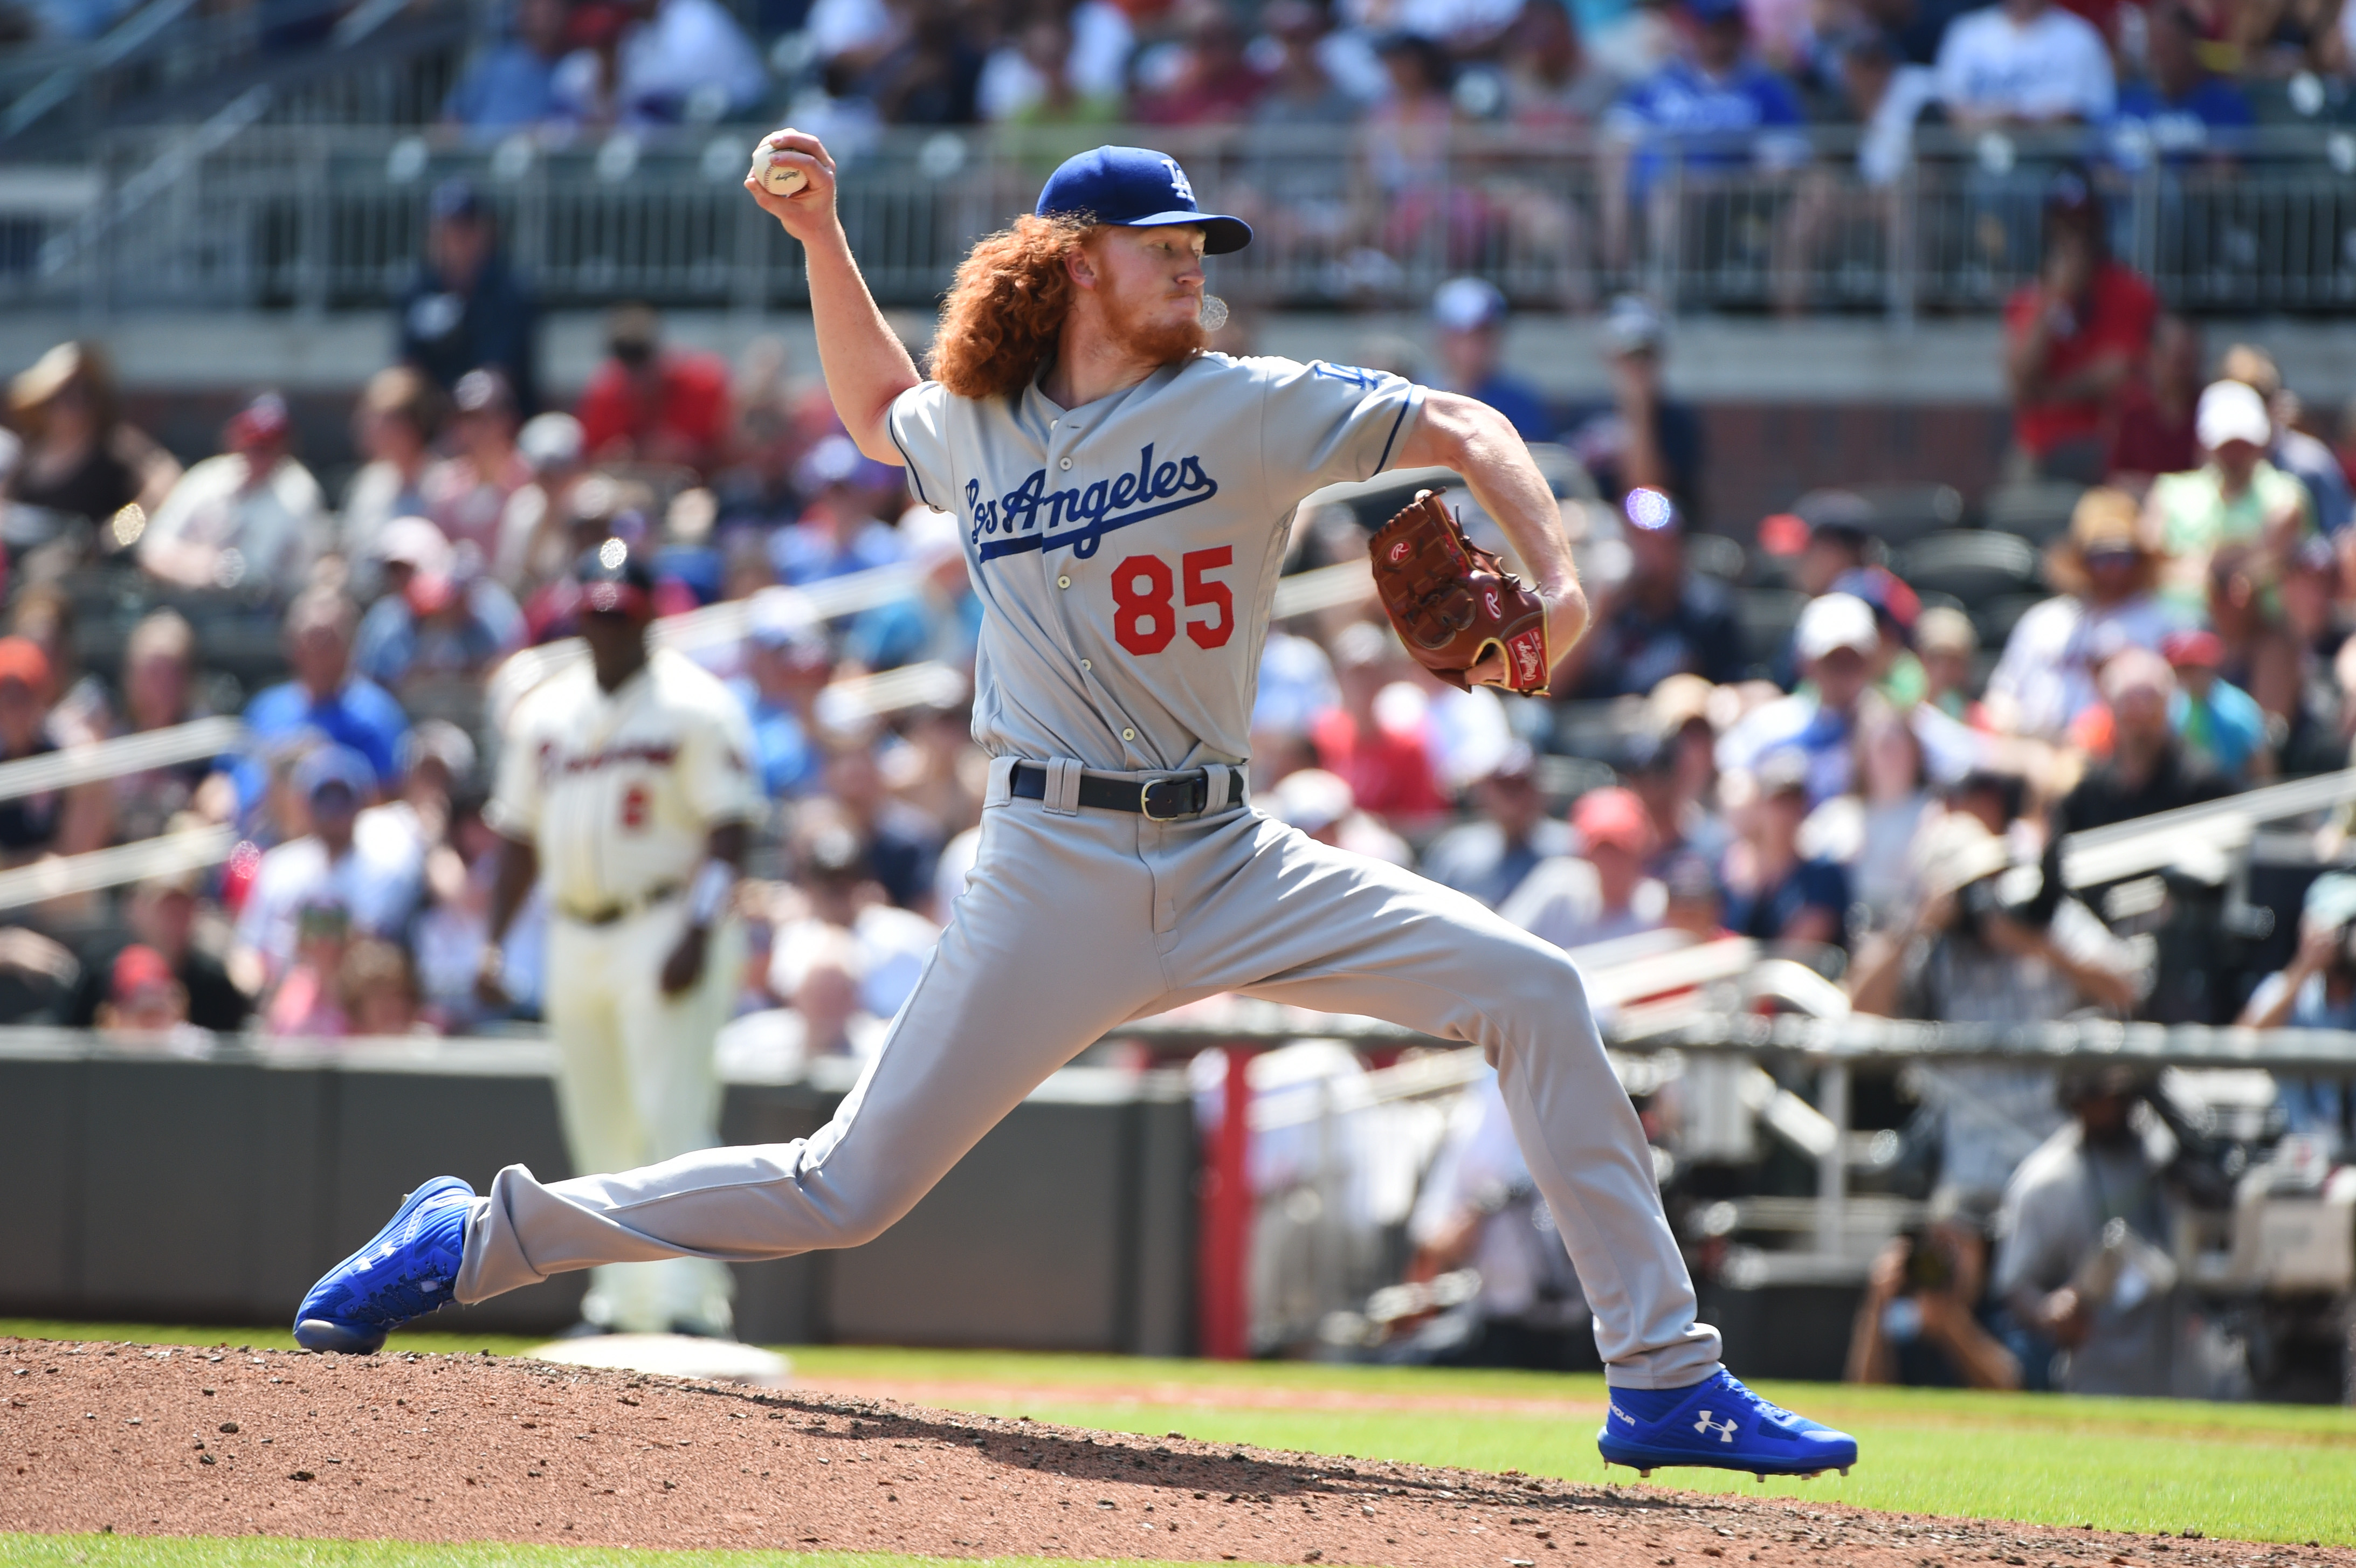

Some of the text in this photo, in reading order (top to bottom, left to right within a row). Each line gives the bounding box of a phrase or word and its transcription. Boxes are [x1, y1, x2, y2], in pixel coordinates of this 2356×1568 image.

[1160, 159, 1195, 202] LA
[965, 442, 1218, 559] Los Angeles
[1111, 544, 1235, 656] 85
[1517, 640, 1539, 681] Rawlings
